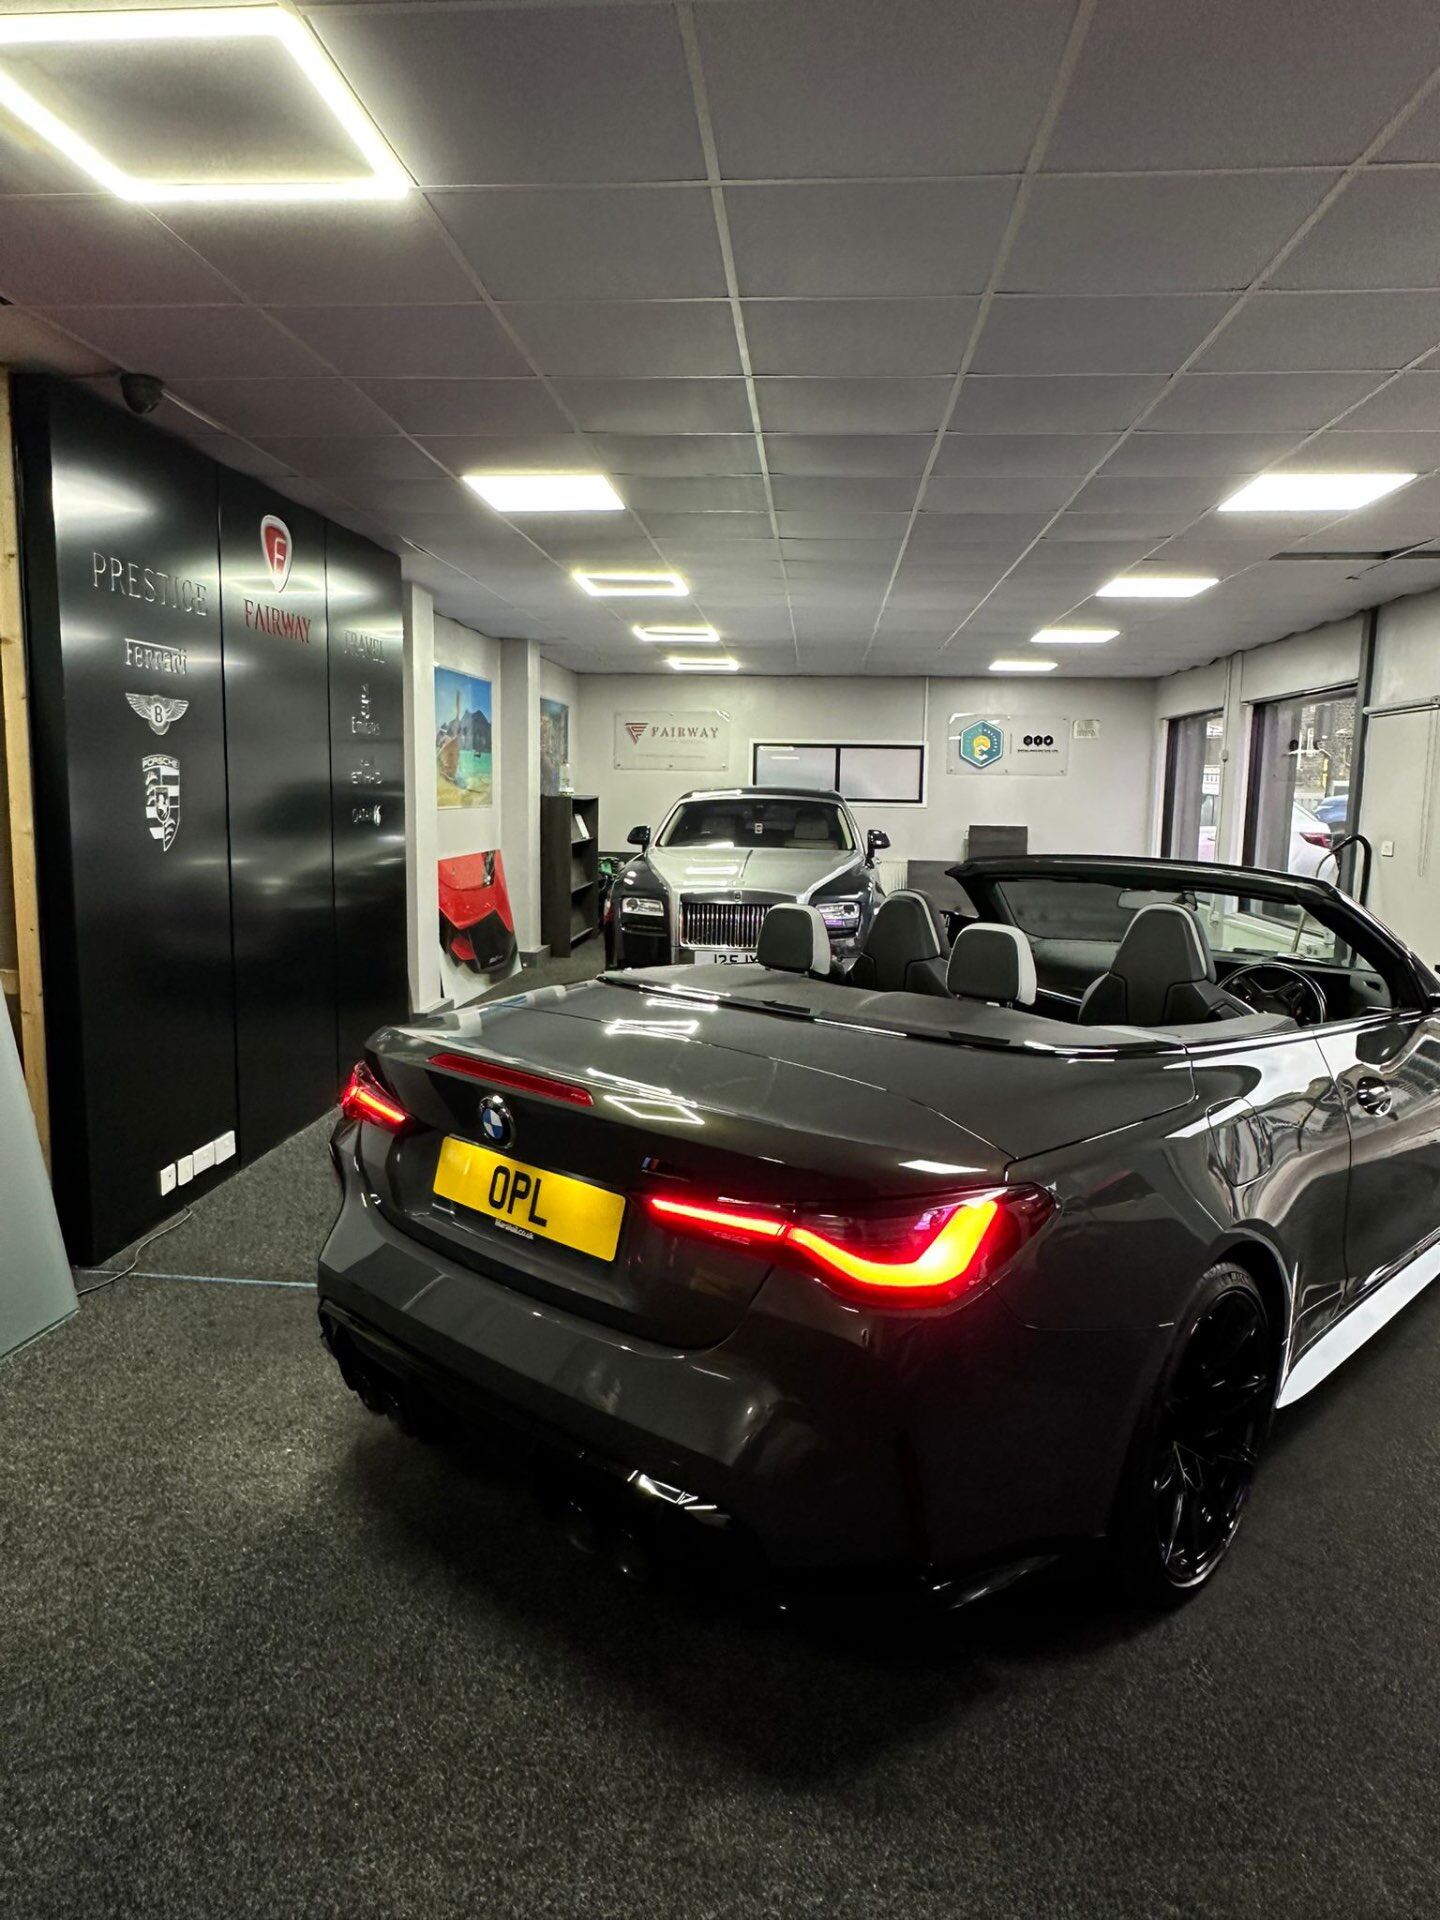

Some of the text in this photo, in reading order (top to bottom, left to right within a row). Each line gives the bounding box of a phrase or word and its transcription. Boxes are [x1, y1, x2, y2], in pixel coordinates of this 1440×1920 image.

[92, 552, 207, 617] PRESTIGE
[243, 598, 311, 644] FAIRWAY
[124, 638, 188, 676] Ferrari
[650, 726, 719, 739] FAIRWAY
[488, 1164, 548, 1228] OPL
